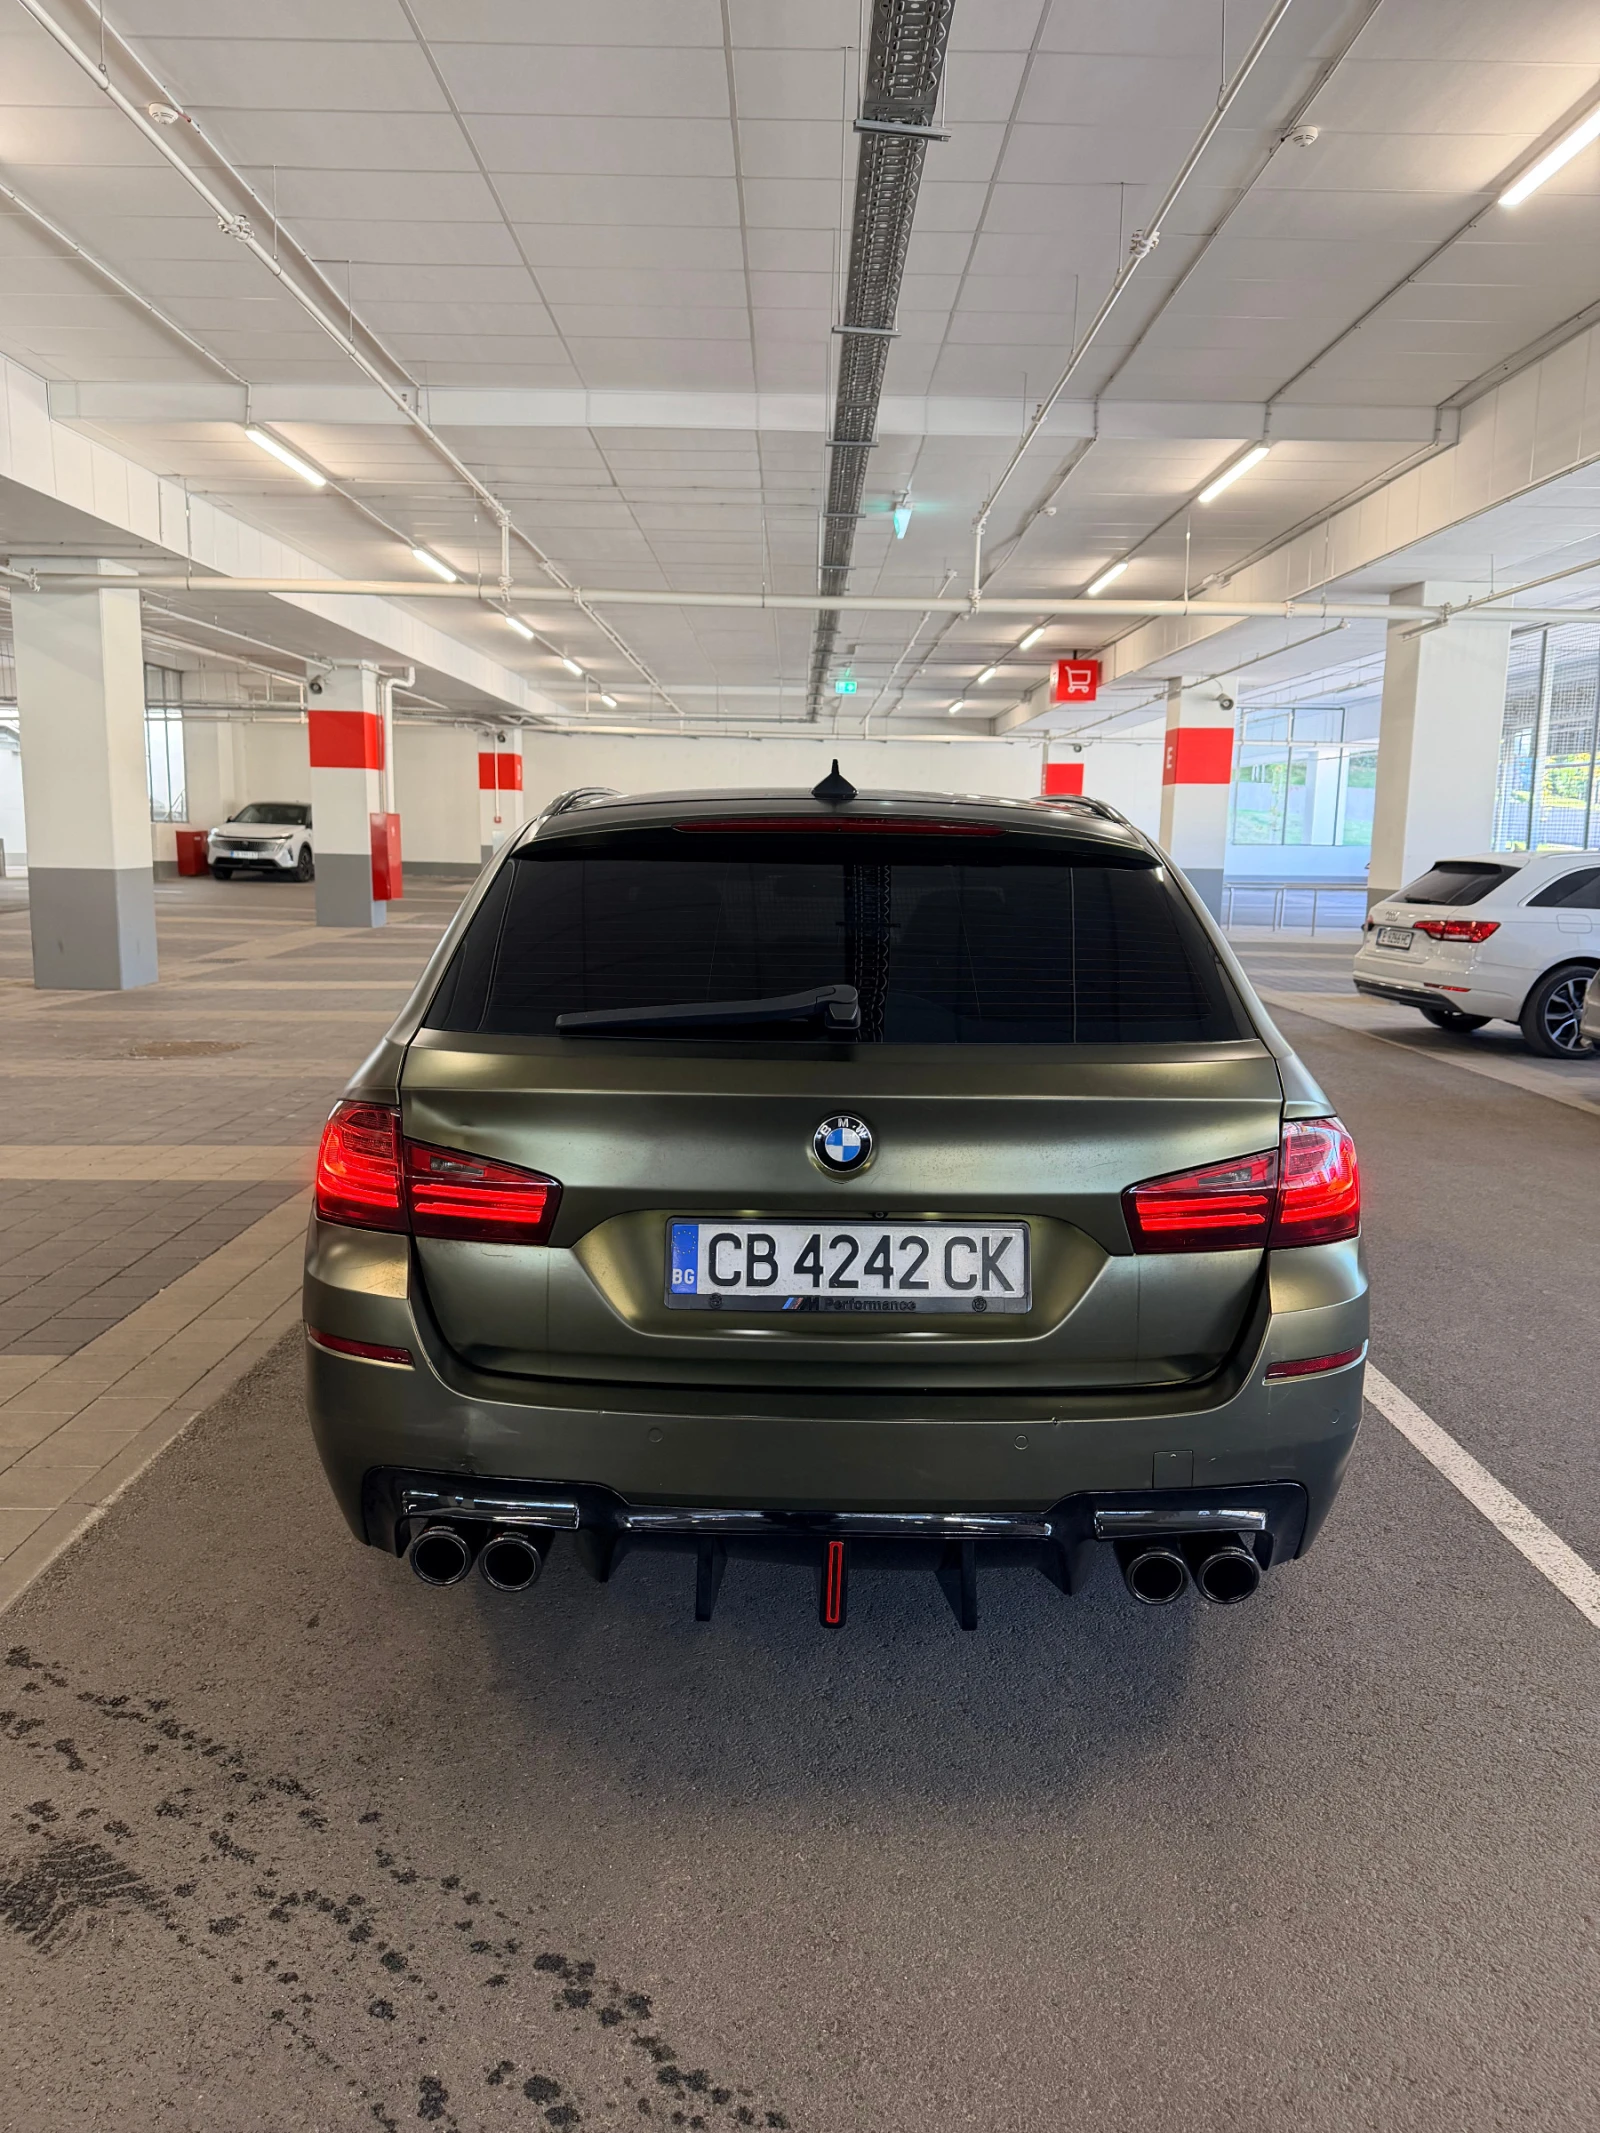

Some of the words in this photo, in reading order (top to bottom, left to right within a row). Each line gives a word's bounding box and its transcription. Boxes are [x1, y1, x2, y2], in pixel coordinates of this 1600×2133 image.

[820, 1118, 868, 1138] BMW
[708, 1233, 779, 1287] CB
[793, 1234, 930, 1290] 4242
[944, 1236, 1015, 1292] CK
[672, 1268, 695, 1285] BG
[824, 1298, 916, 1311] Performance
